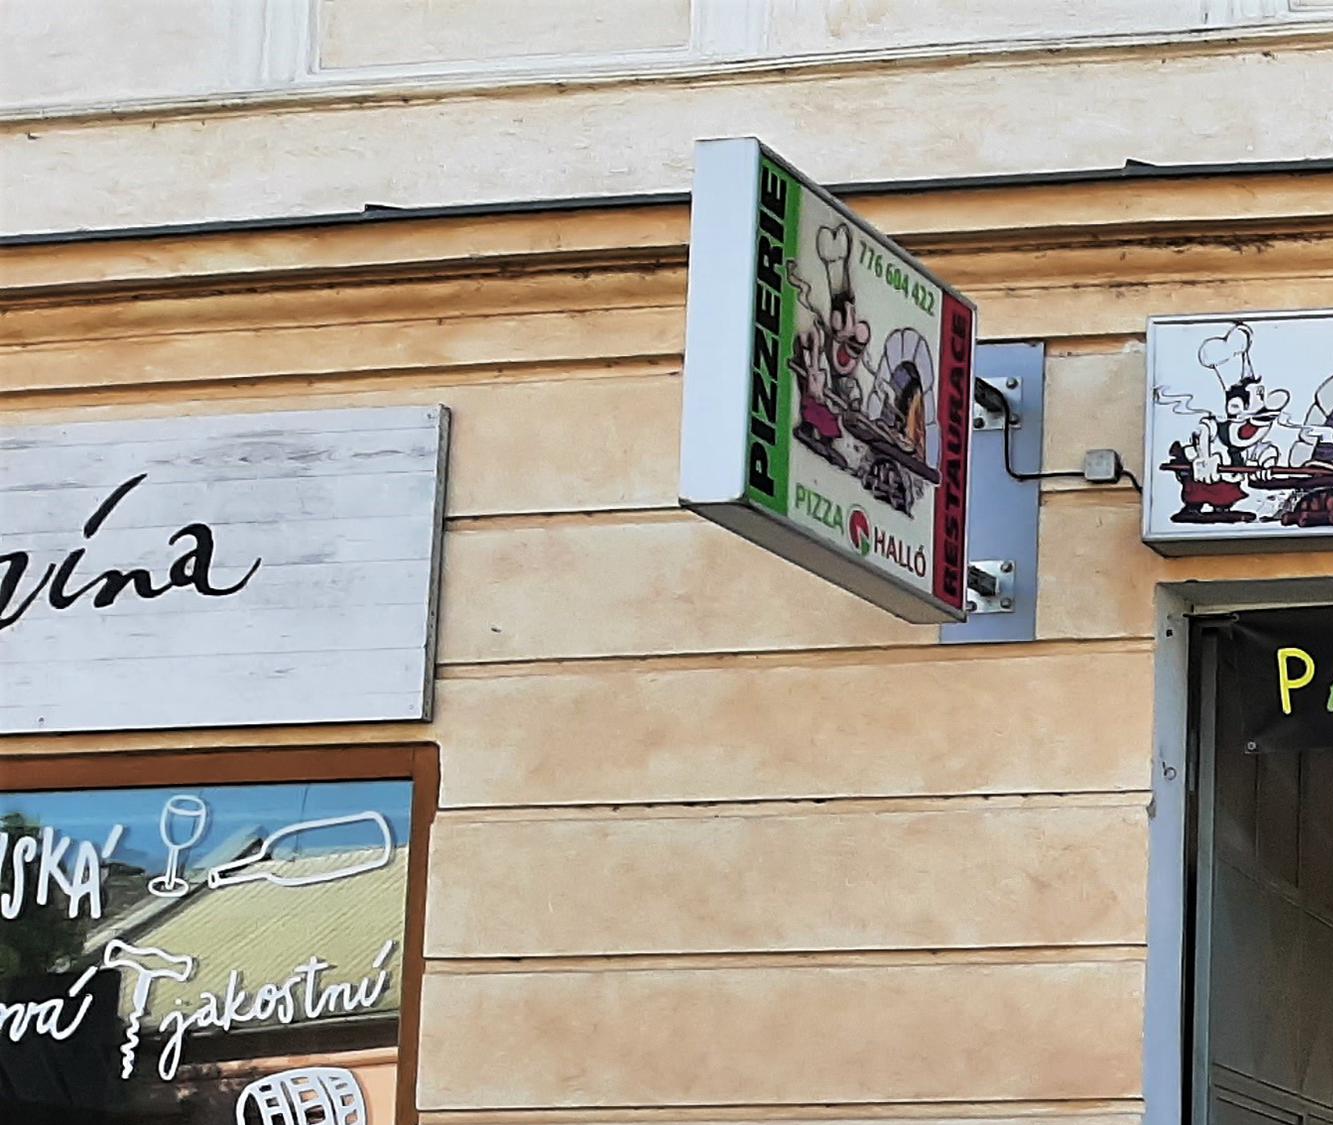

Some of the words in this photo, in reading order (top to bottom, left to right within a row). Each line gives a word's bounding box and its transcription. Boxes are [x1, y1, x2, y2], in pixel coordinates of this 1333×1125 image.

[859, 240, 883, 278] 776
[911, 281, 936, 317] 422
[751, 164, 788, 496] PIZZERIE
[943, 313, 967, 596] RESTAURACE
[795, 482, 844, 536] PIZZA
[874, 526, 927, 578] HALLÓ
[0, 824, 124, 919] SKÁ
